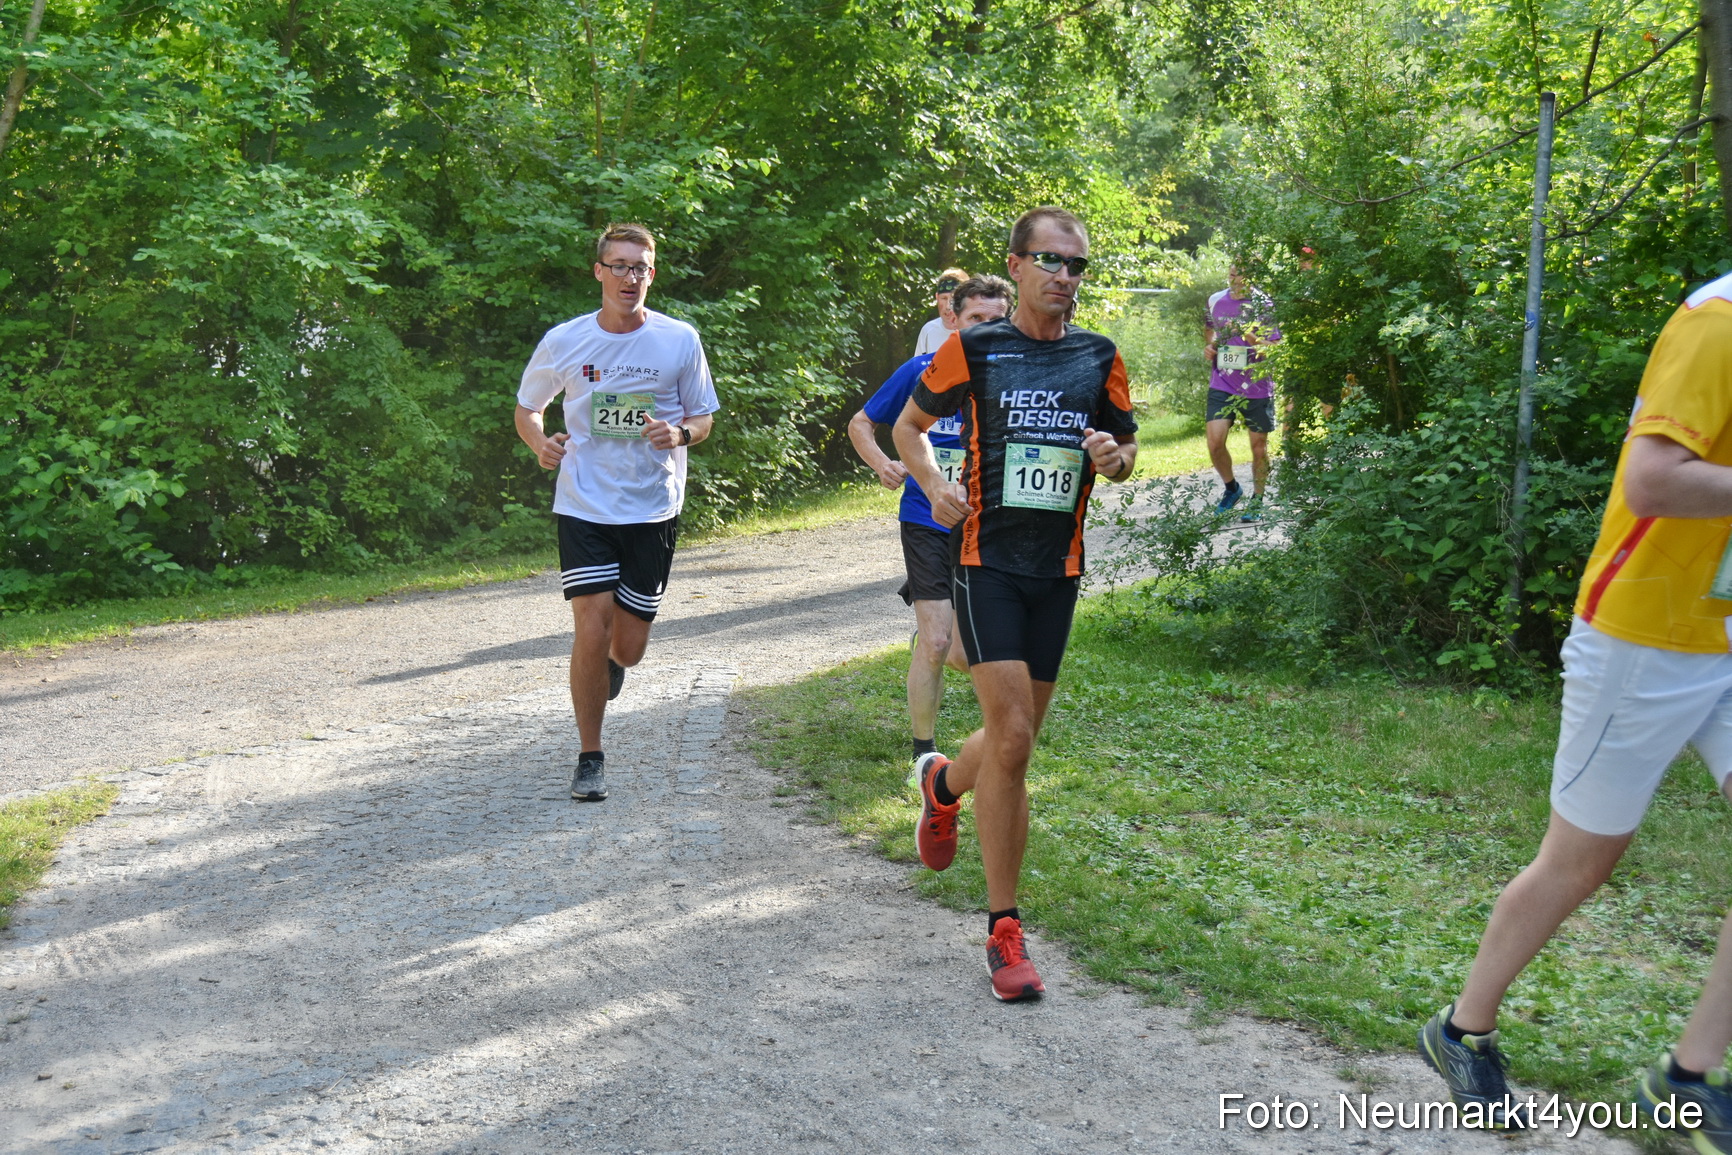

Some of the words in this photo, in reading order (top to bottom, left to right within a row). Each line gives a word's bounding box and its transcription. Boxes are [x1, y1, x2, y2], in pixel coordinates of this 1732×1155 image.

[1223, 353, 1239, 363] 887
[1000, 390, 1064, 408] HECK
[598, 408, 646, 427] 2145
[1007, 409, 1088, 430] DESIGN
[1013, 431, 1044, 439] einfach
[1016, 467, 1072, 494] 1018
